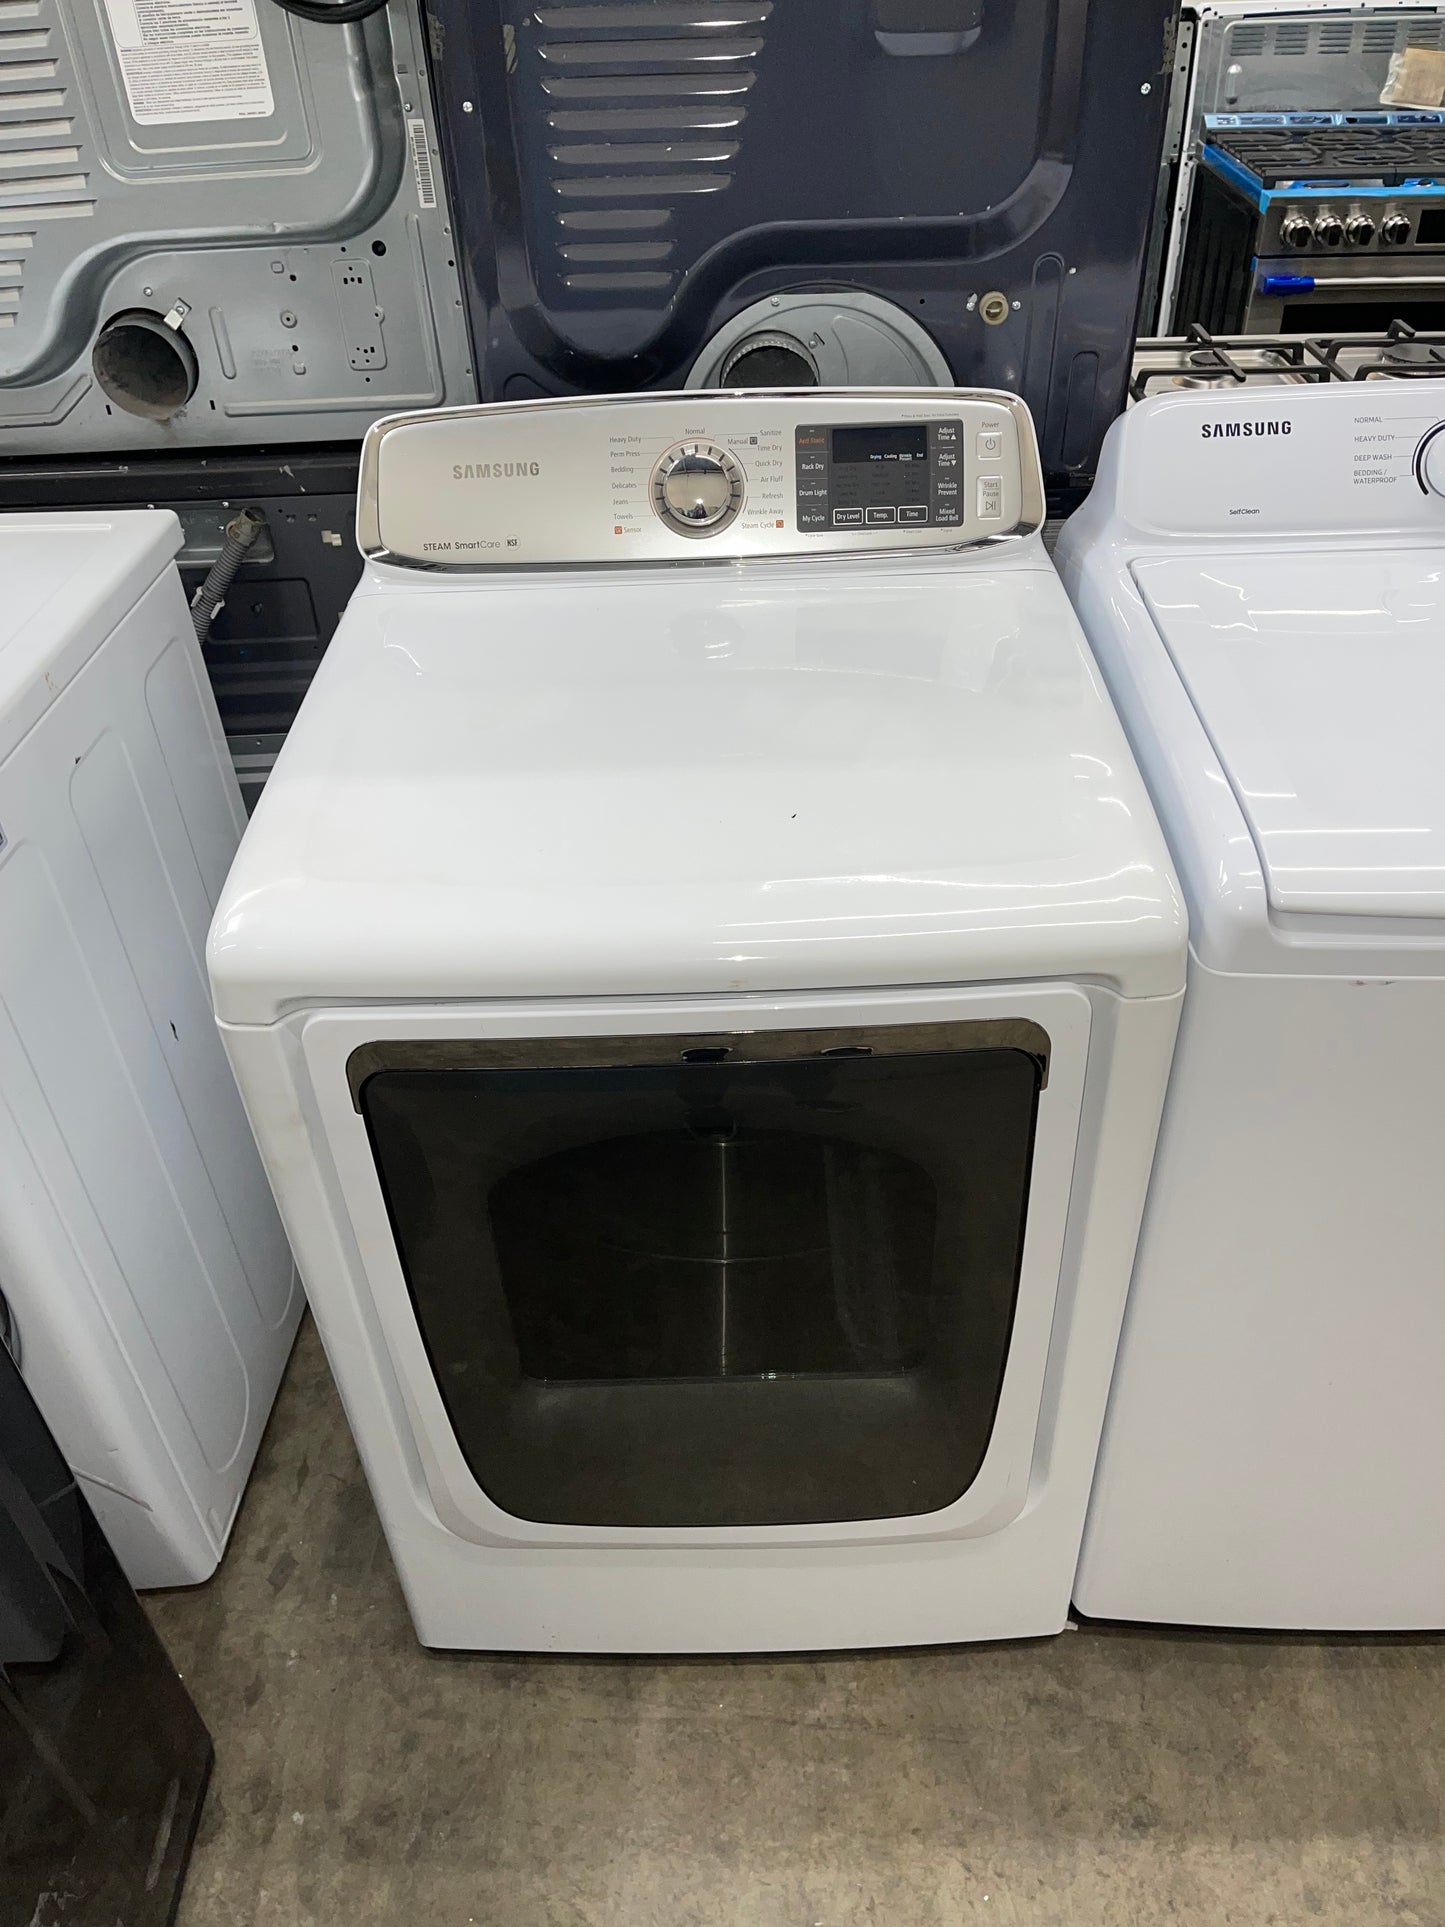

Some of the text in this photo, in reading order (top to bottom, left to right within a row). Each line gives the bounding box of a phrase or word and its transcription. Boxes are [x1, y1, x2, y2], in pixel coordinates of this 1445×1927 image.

[1201, 420, 1292, 438] SAMSUNG
[452, 462, 540, 480] SAMSUNG
[1354, 476, 1398, 484] WATERPROOF
[814, 488, 828, 496] Light
[836, 512, 846, 520] Dry
[423, 538, 518, 551] STEAM SmartCare NSF
